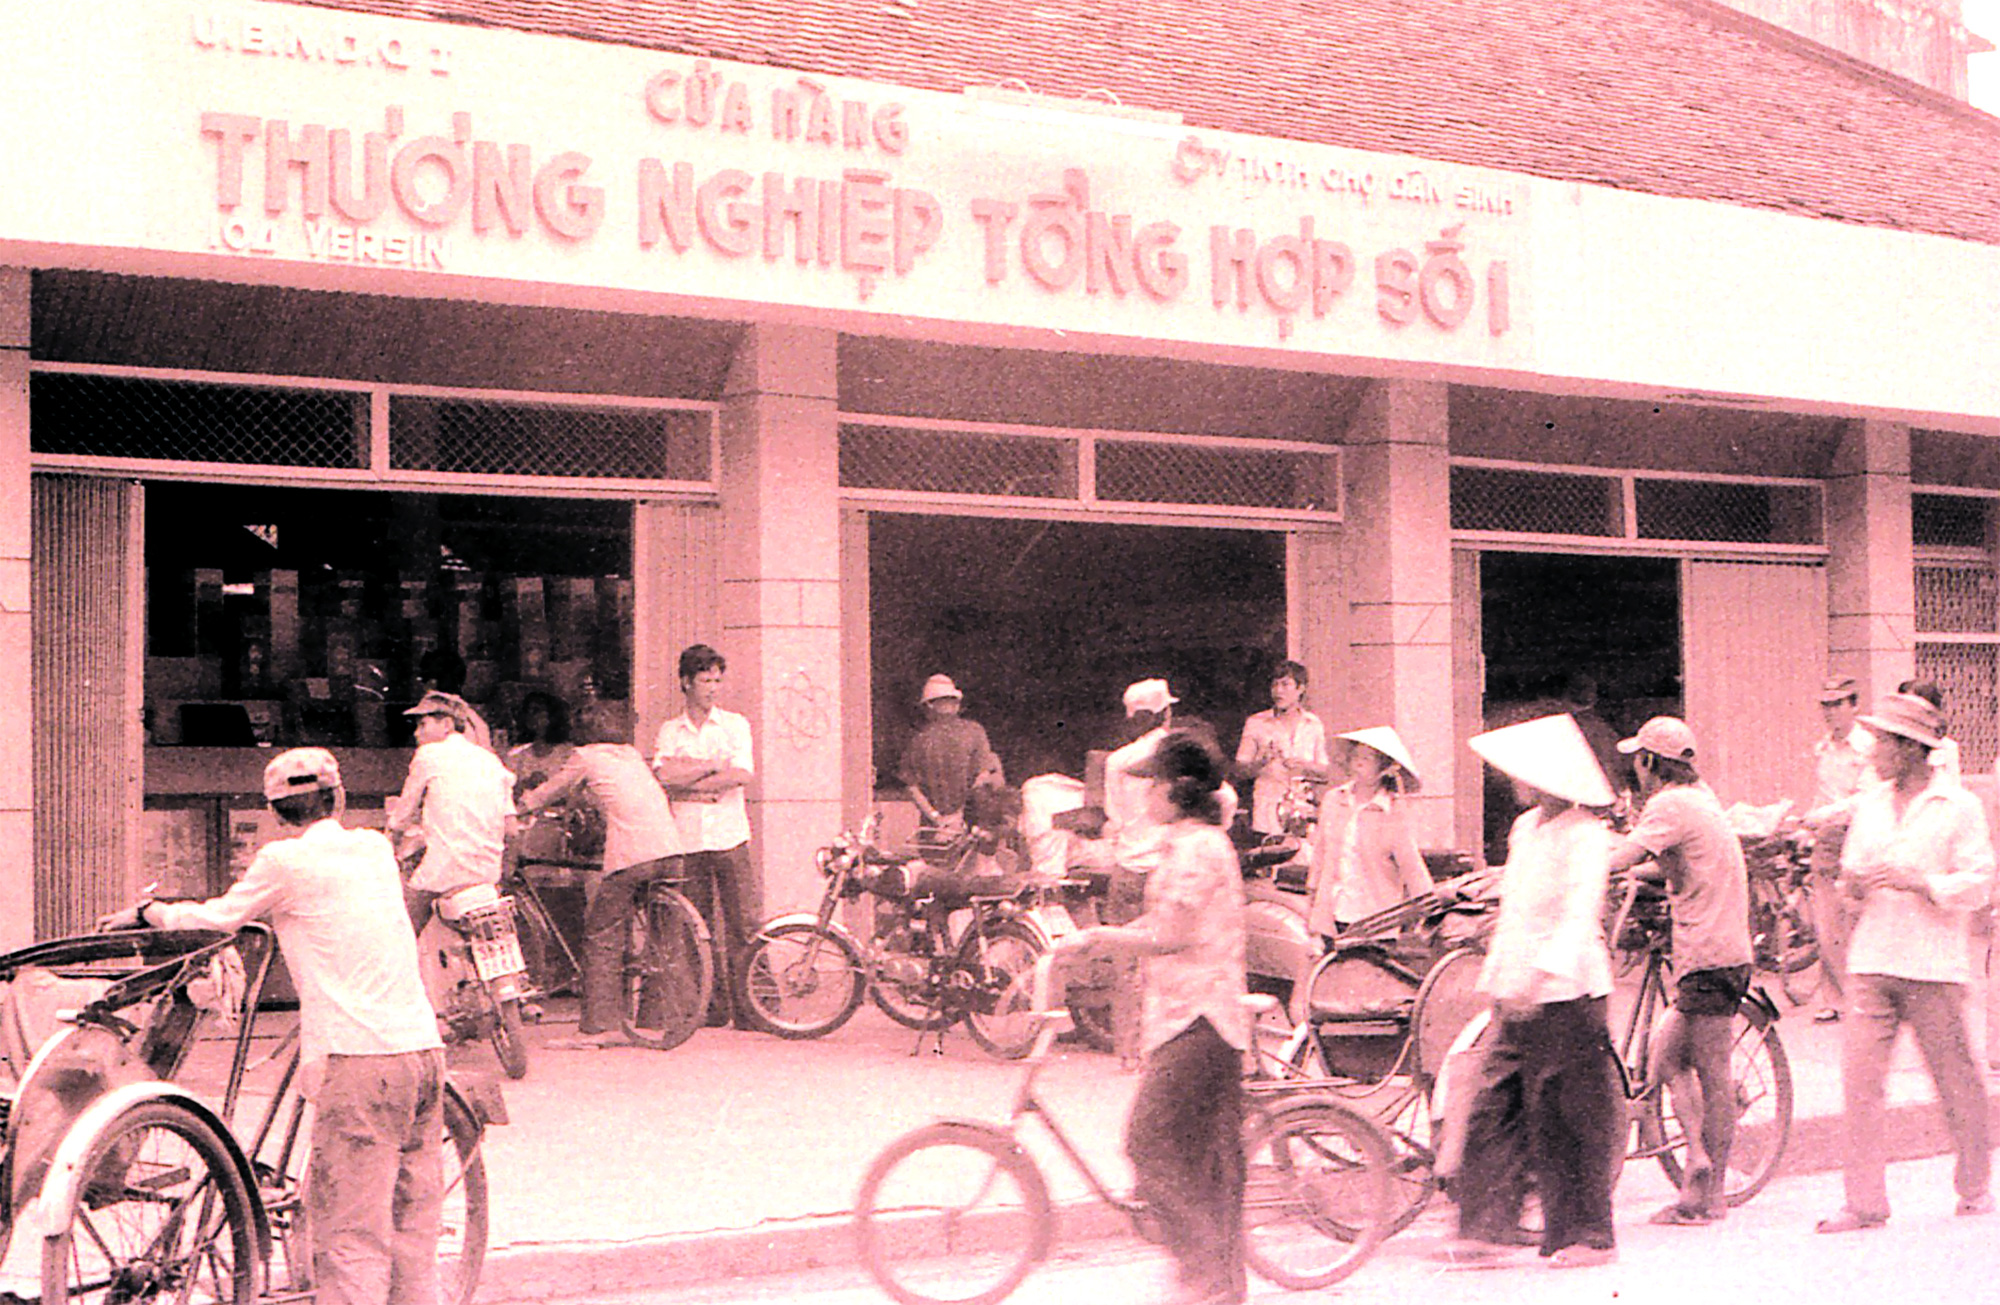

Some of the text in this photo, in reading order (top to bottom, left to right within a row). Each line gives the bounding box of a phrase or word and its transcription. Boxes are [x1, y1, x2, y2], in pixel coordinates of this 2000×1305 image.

[645, 60, 909, 155] CỬA HÀNG
[200, 104, 605, 243] THƯƠNG
[638, 156, 943, 303] NGHIỆP
[971, 168, 1189, 304] TỔNG
[1210, 215, 1356, 340] HỢP
[1375, 223, 1475, 331] SỐ
[306, 220, 452, 269] YERSIN
